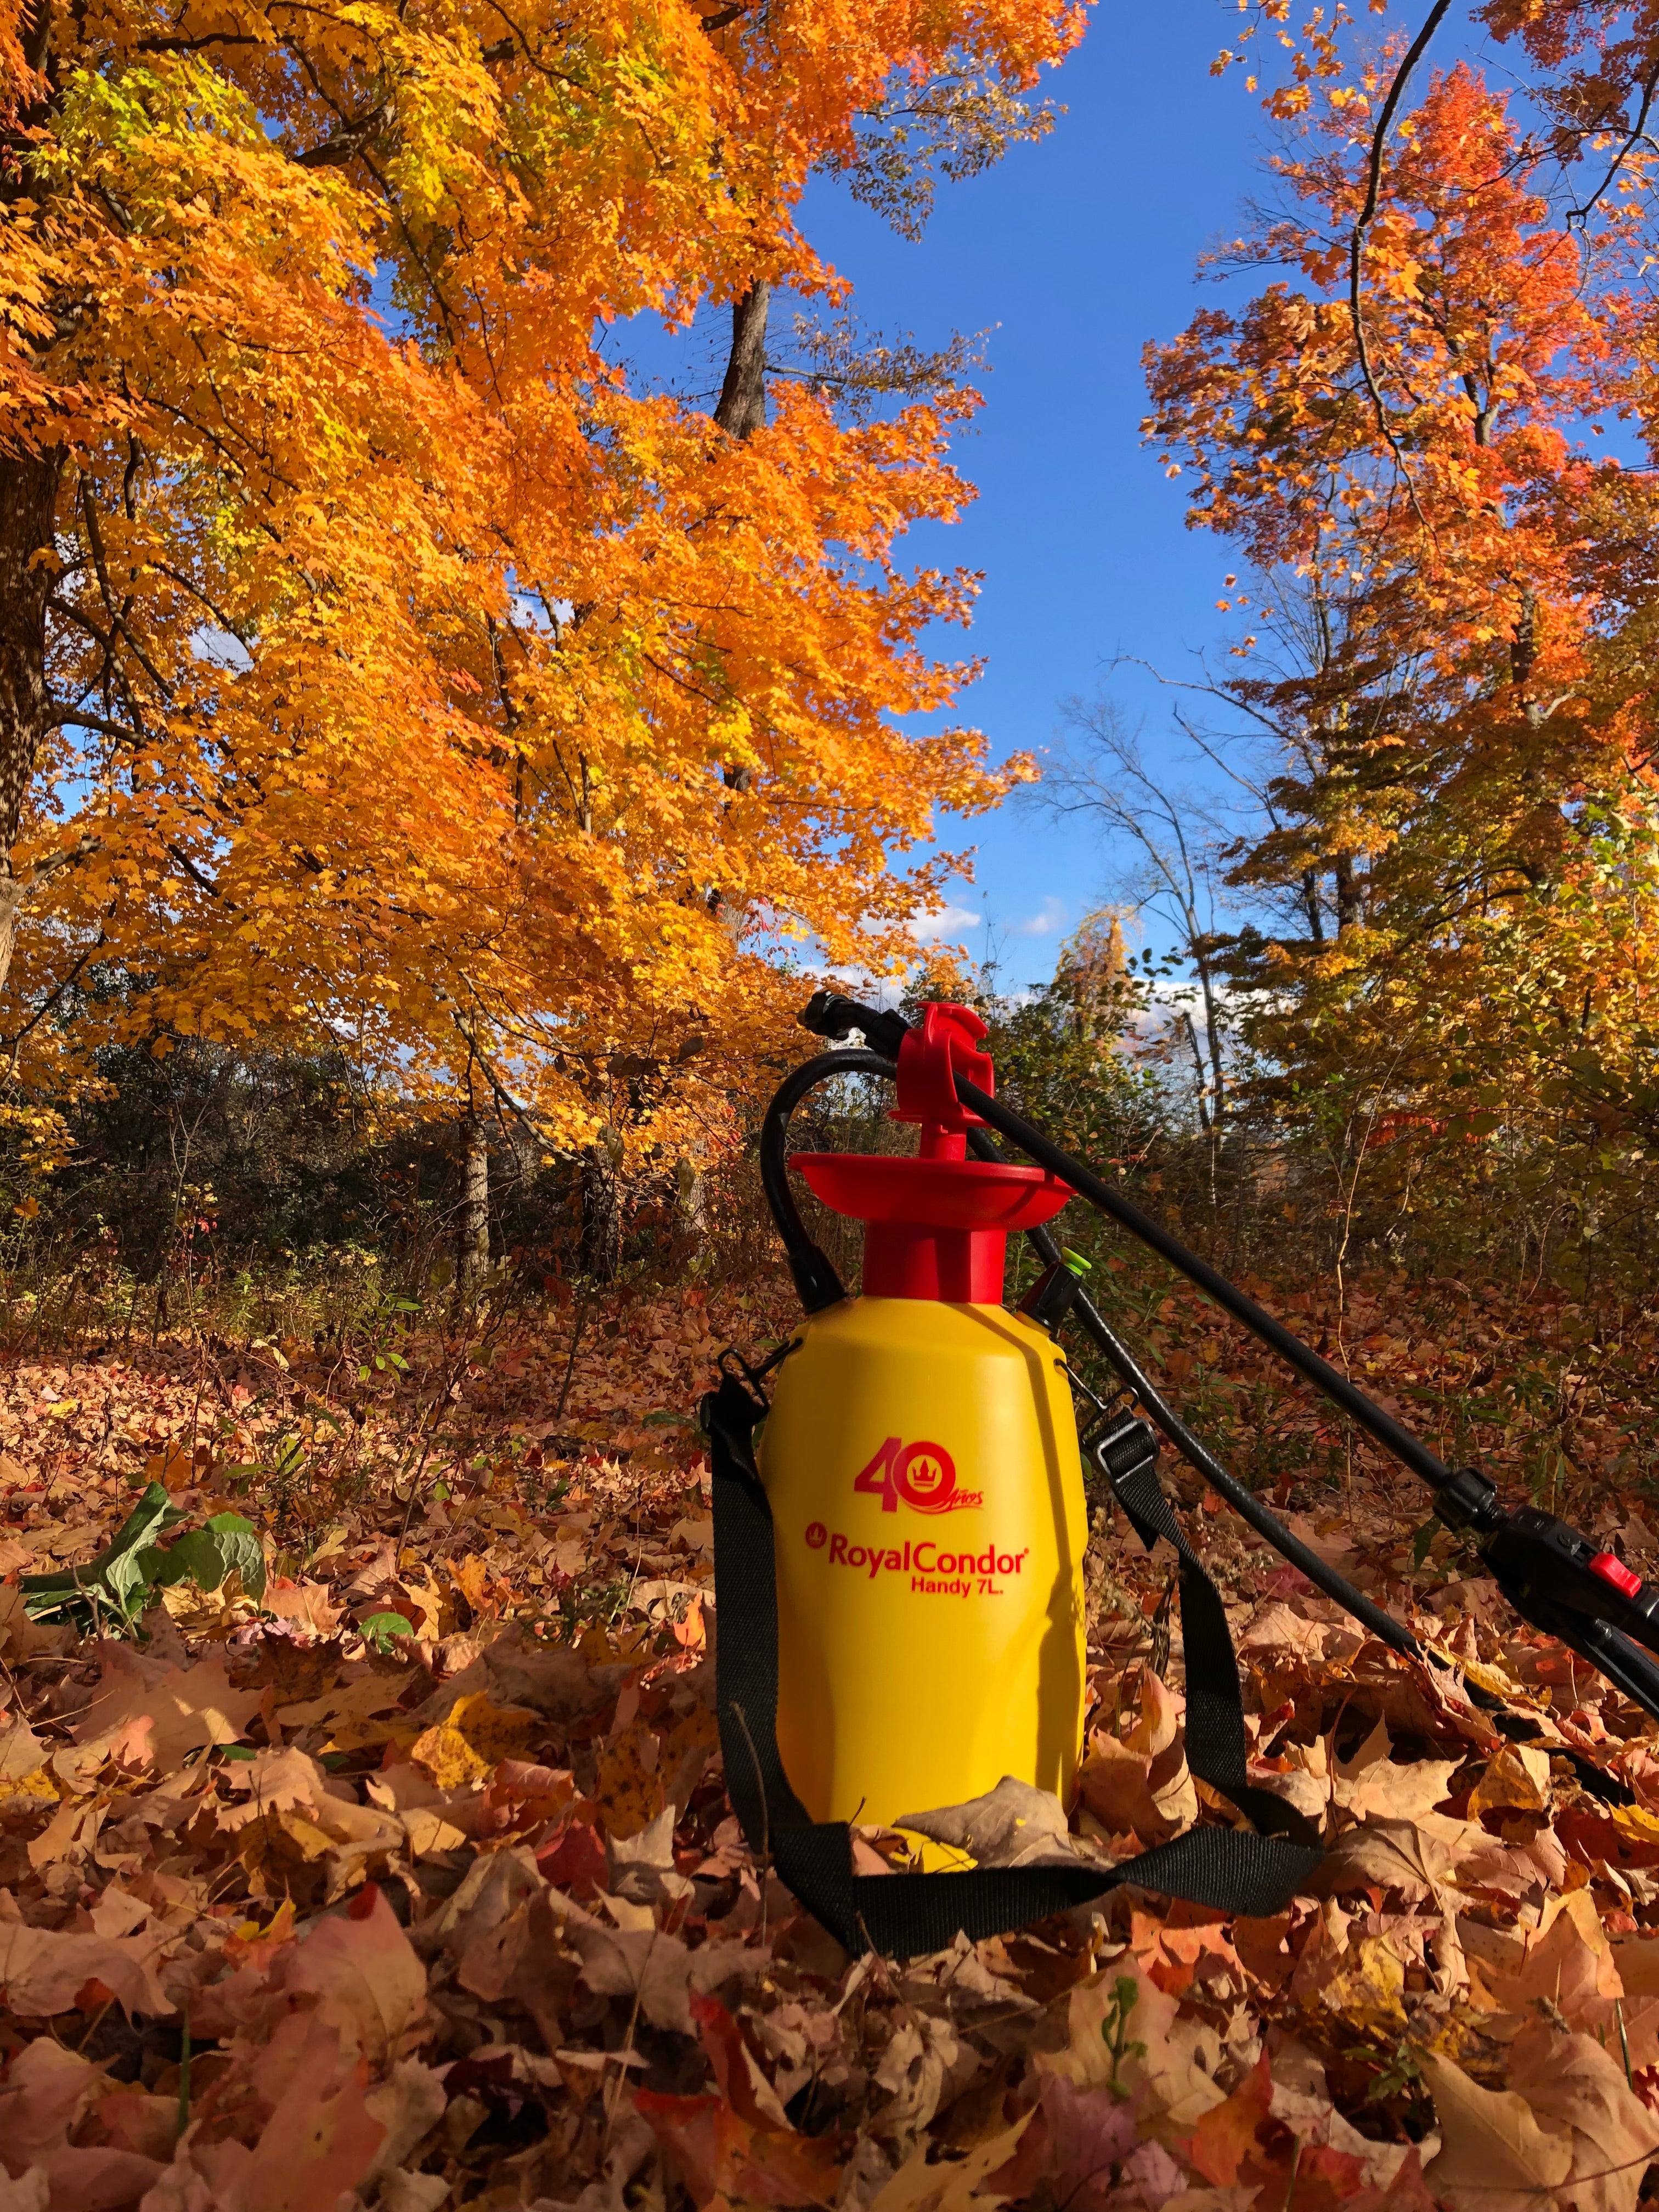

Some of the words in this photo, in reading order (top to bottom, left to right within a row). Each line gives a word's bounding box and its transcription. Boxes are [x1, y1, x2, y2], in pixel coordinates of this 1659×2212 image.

[854, 1436, 956, 1513] 40
[911, 1576, 971, 1598] Handy
[977, 1578, 1003, 1595] 7L.
